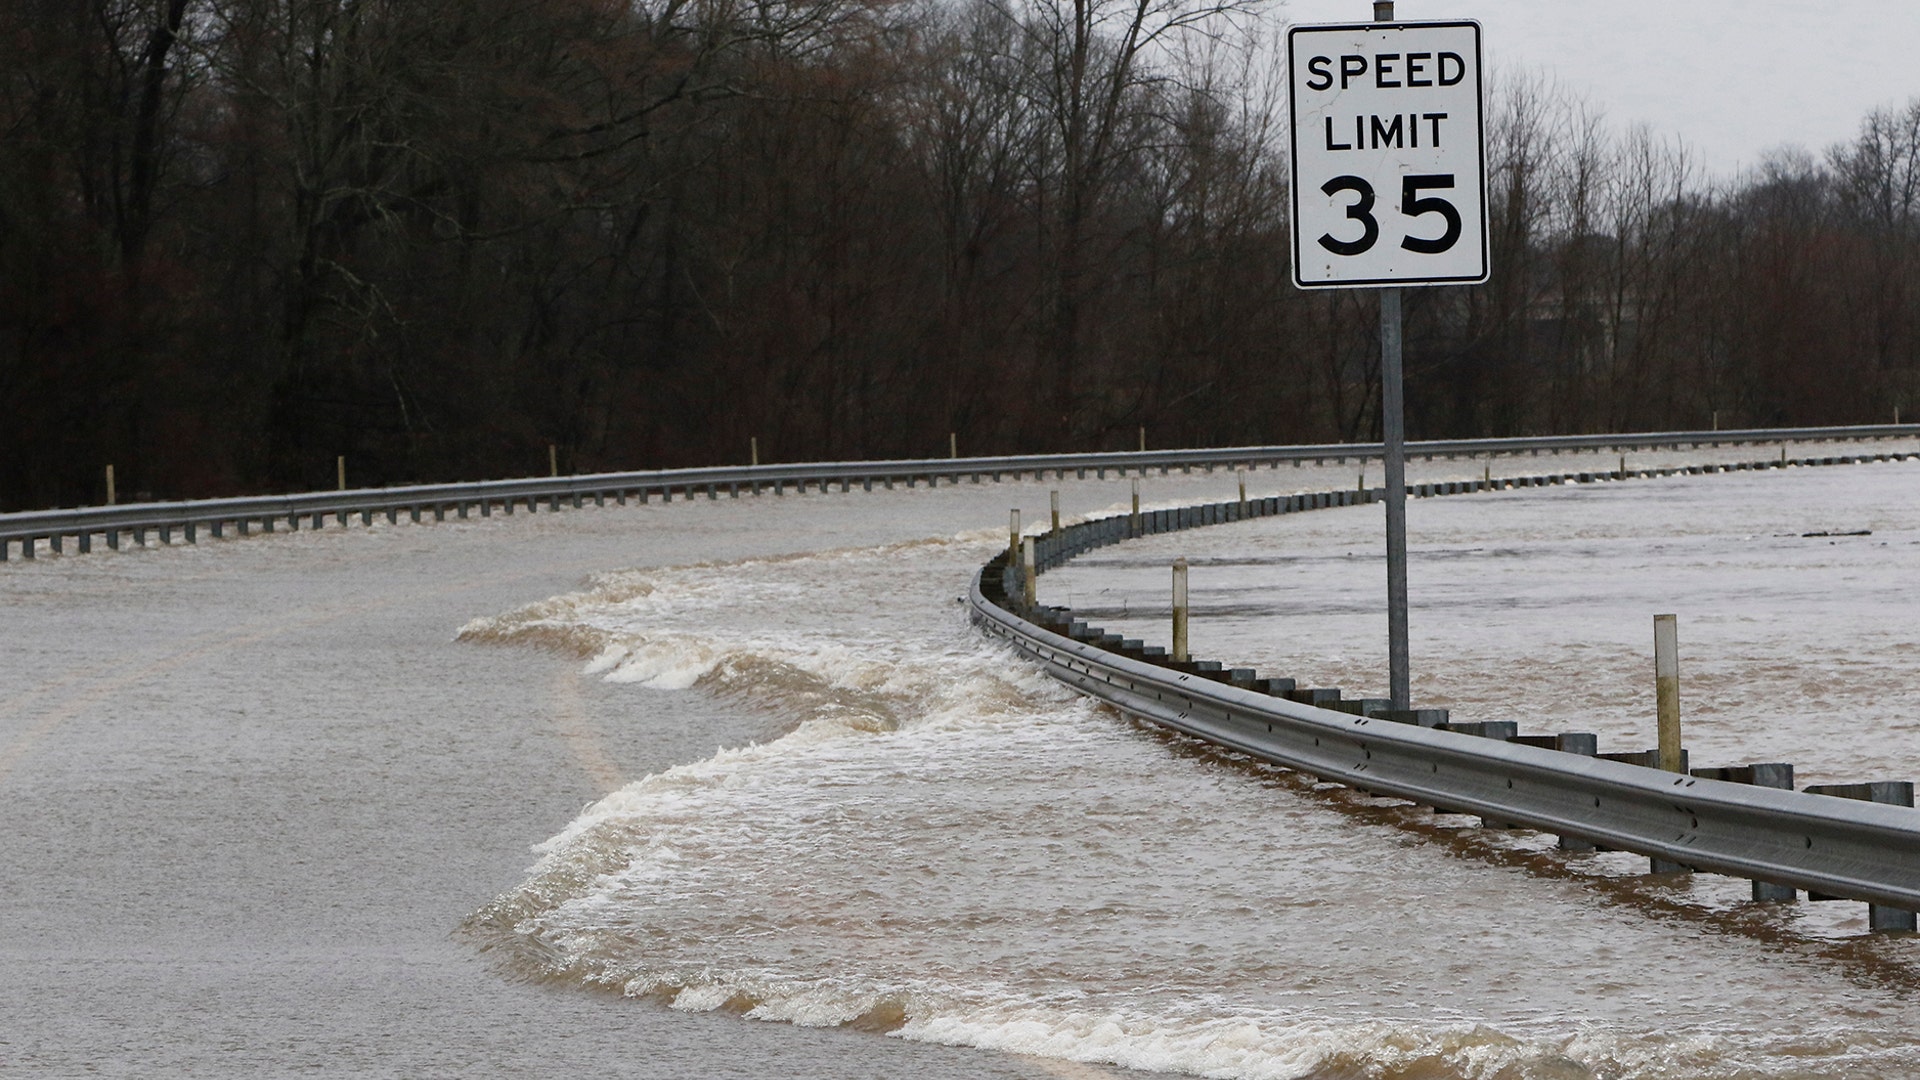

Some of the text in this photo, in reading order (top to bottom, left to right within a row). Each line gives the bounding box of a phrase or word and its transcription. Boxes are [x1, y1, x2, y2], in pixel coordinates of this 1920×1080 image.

[1305, 51, 1466, 91] SPEED
[1325, 112, 1448, 151] LIMIT
[1317, 173, 1462, 256] 35
